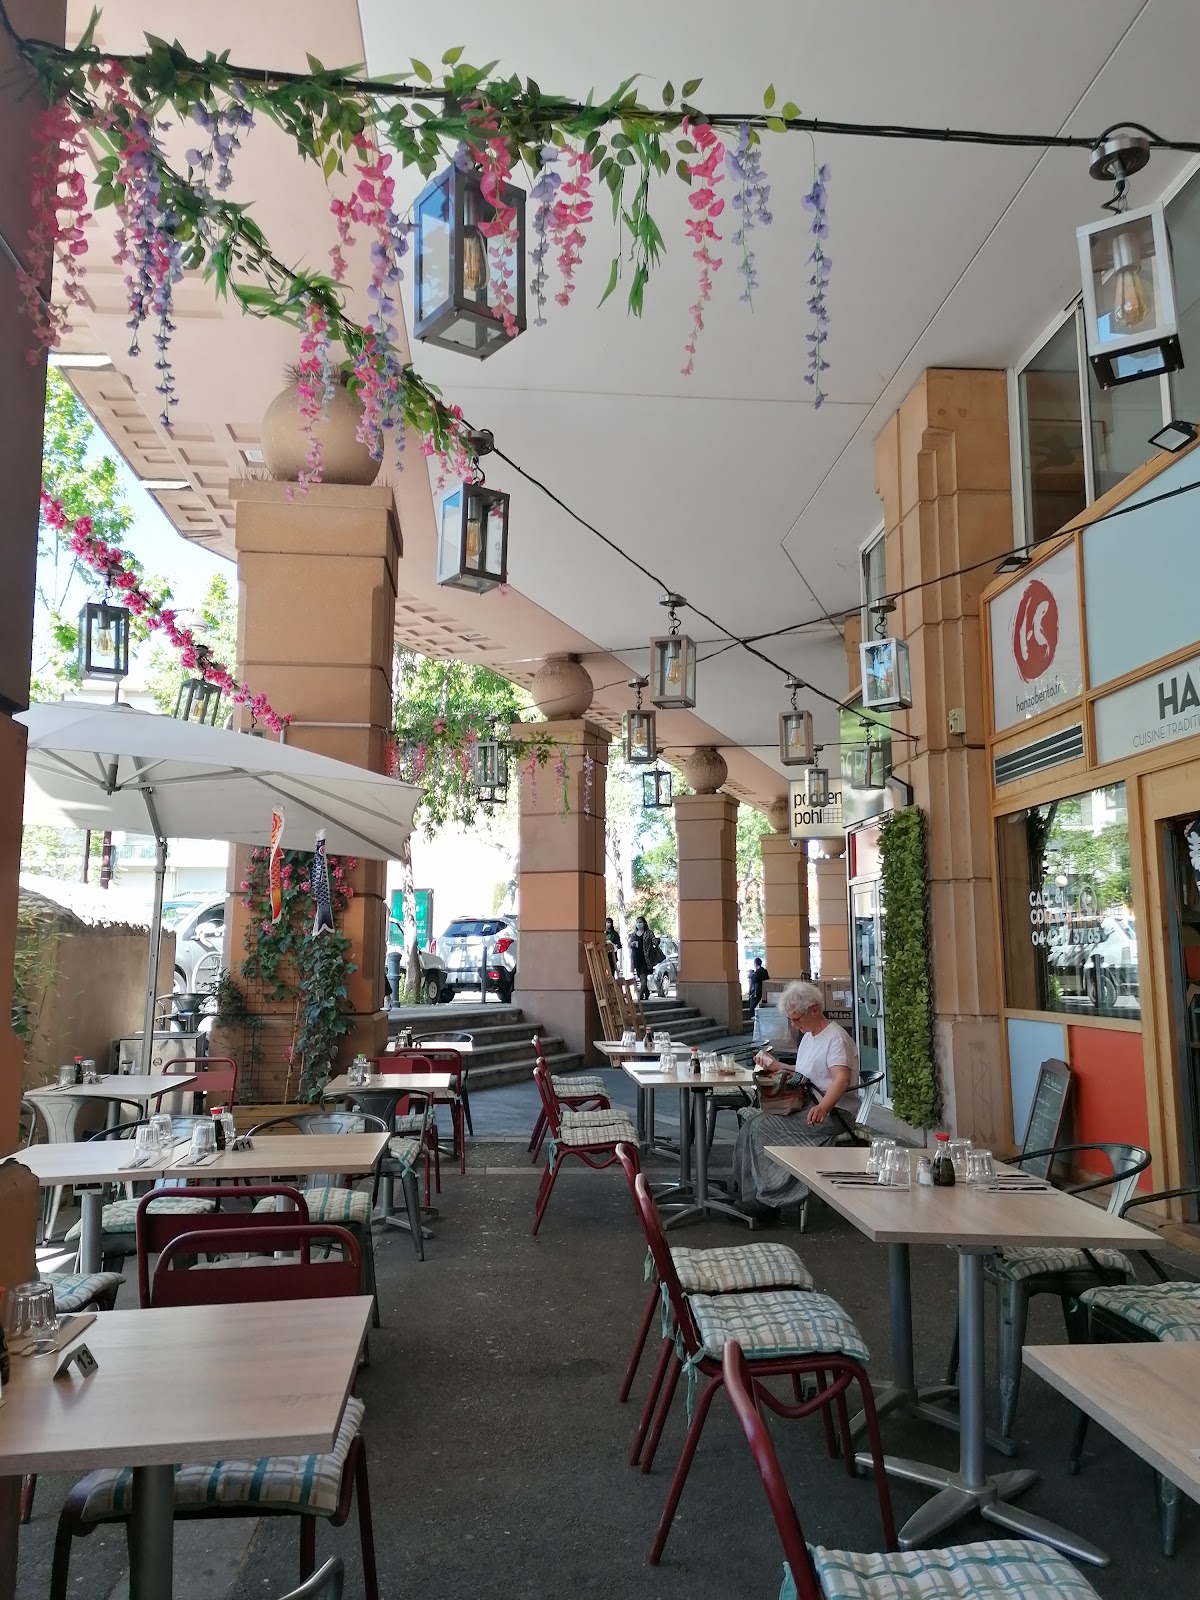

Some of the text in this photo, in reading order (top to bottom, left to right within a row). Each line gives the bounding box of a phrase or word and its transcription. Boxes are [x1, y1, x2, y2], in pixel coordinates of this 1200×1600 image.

[1016, 675, 1060, 712] hanzobento.fr
[1133, 725, 1165, 747] CUISINE
[795, 809, 822, 827] pohl
[1029, 890, 1053, 906] CALL
[1073, 928, 1085, 944] 37
[1088, 927, 1101, 943] 65
[240, 1140, 251, 1149] 11
[77, 1350, 93, 1369] 13
